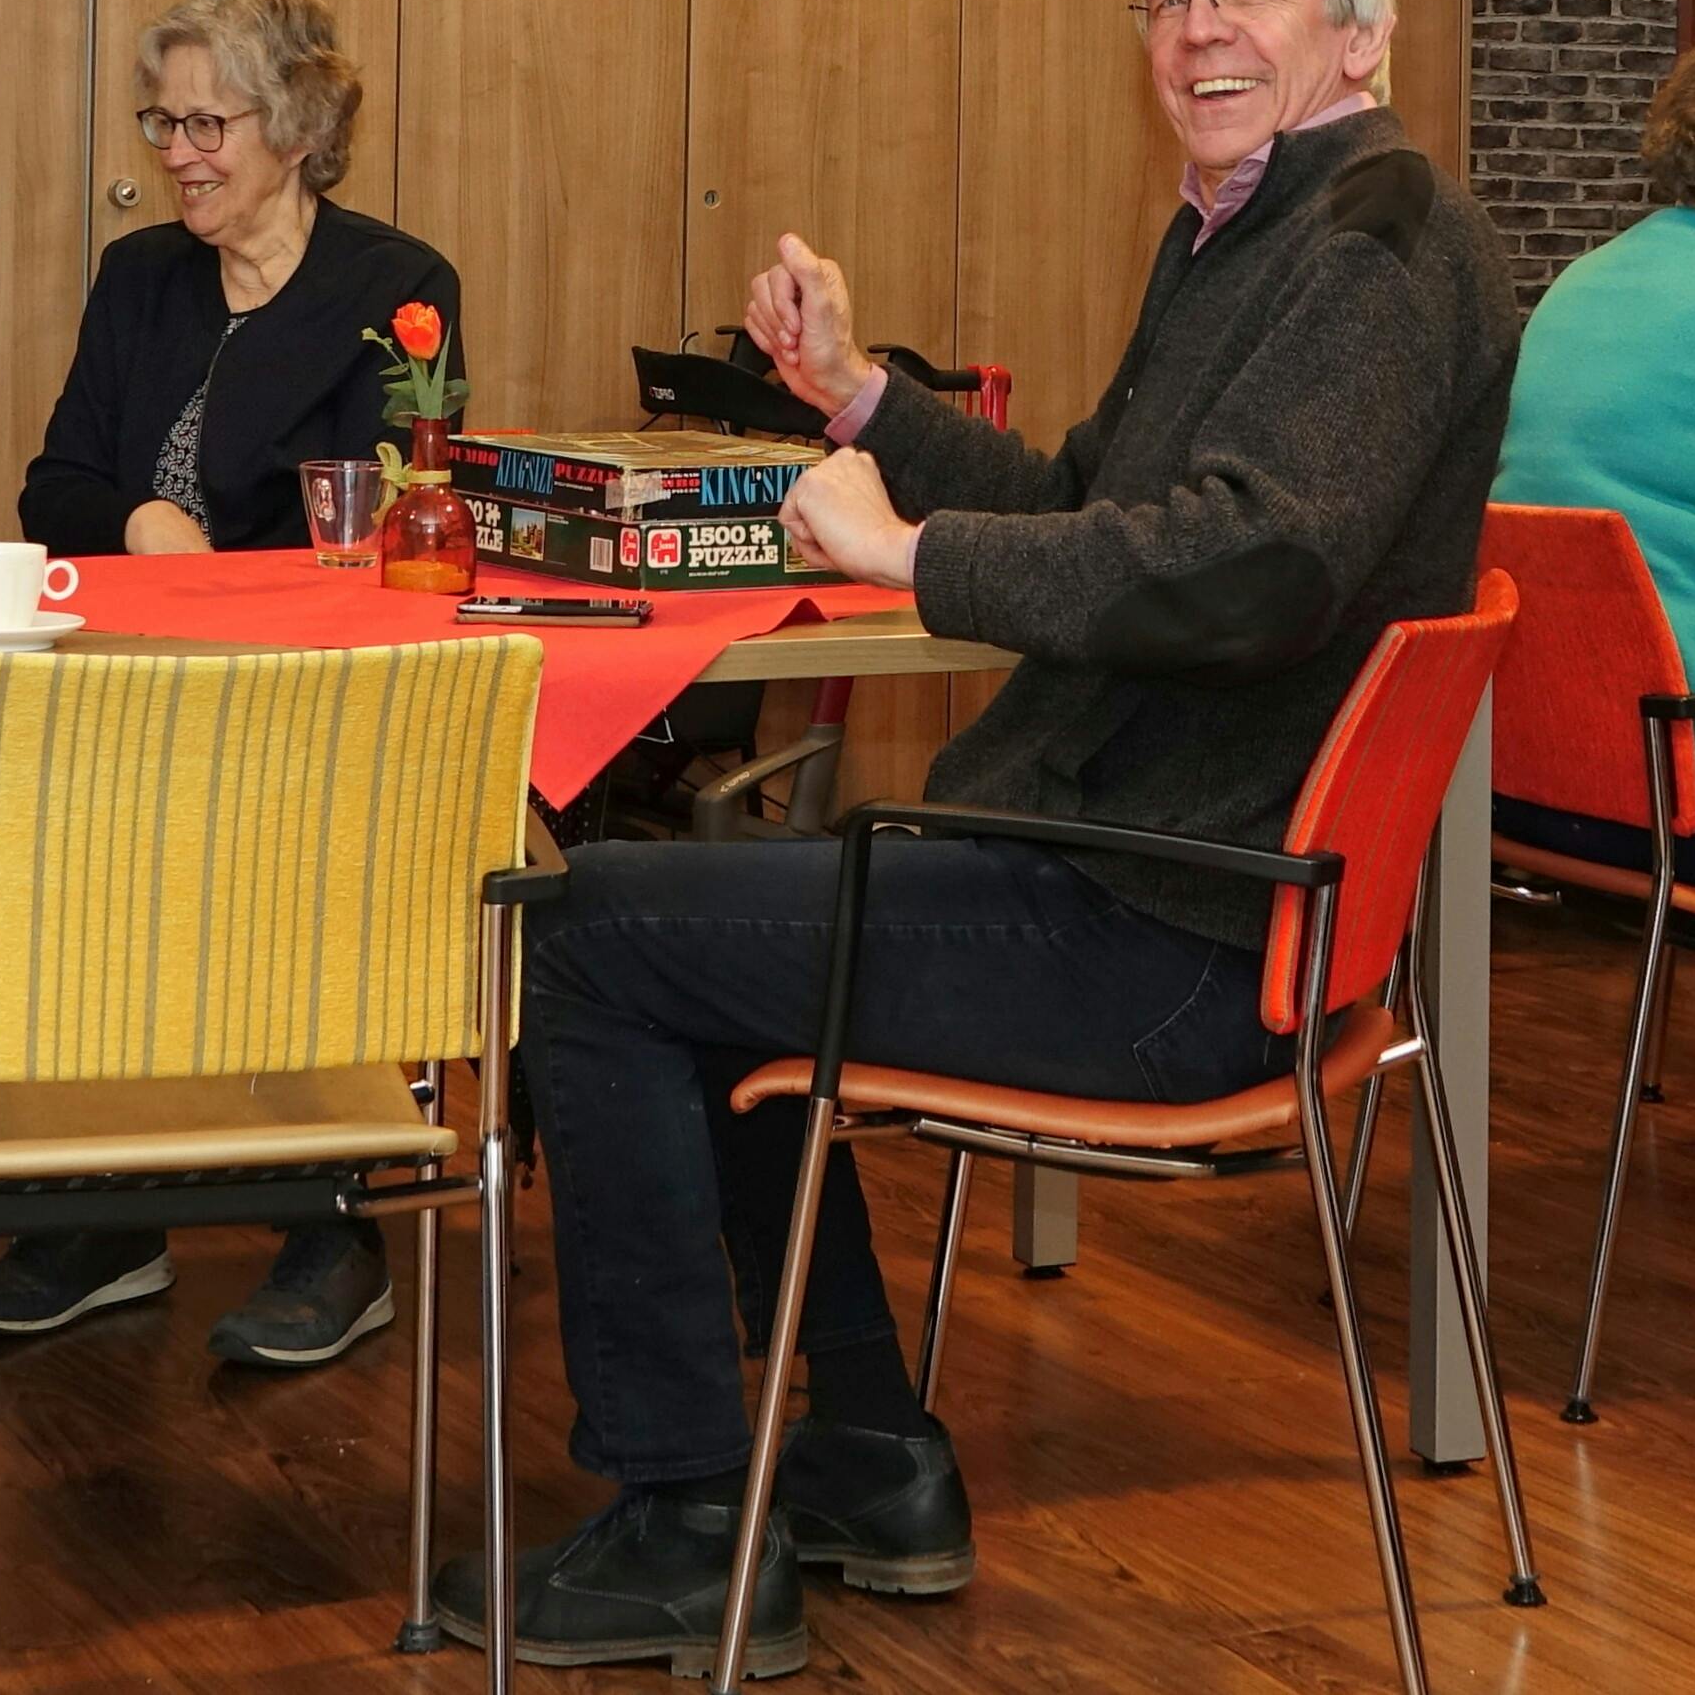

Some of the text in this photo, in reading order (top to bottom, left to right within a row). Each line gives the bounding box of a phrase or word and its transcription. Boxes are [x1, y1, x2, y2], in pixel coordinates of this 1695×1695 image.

[762, 465, 809, 503] SIZ
[475, 525, 504, 553] ZLE
[688, 524, 747, 547] 1500
[688, 544, 779, 568] PUZZLE
